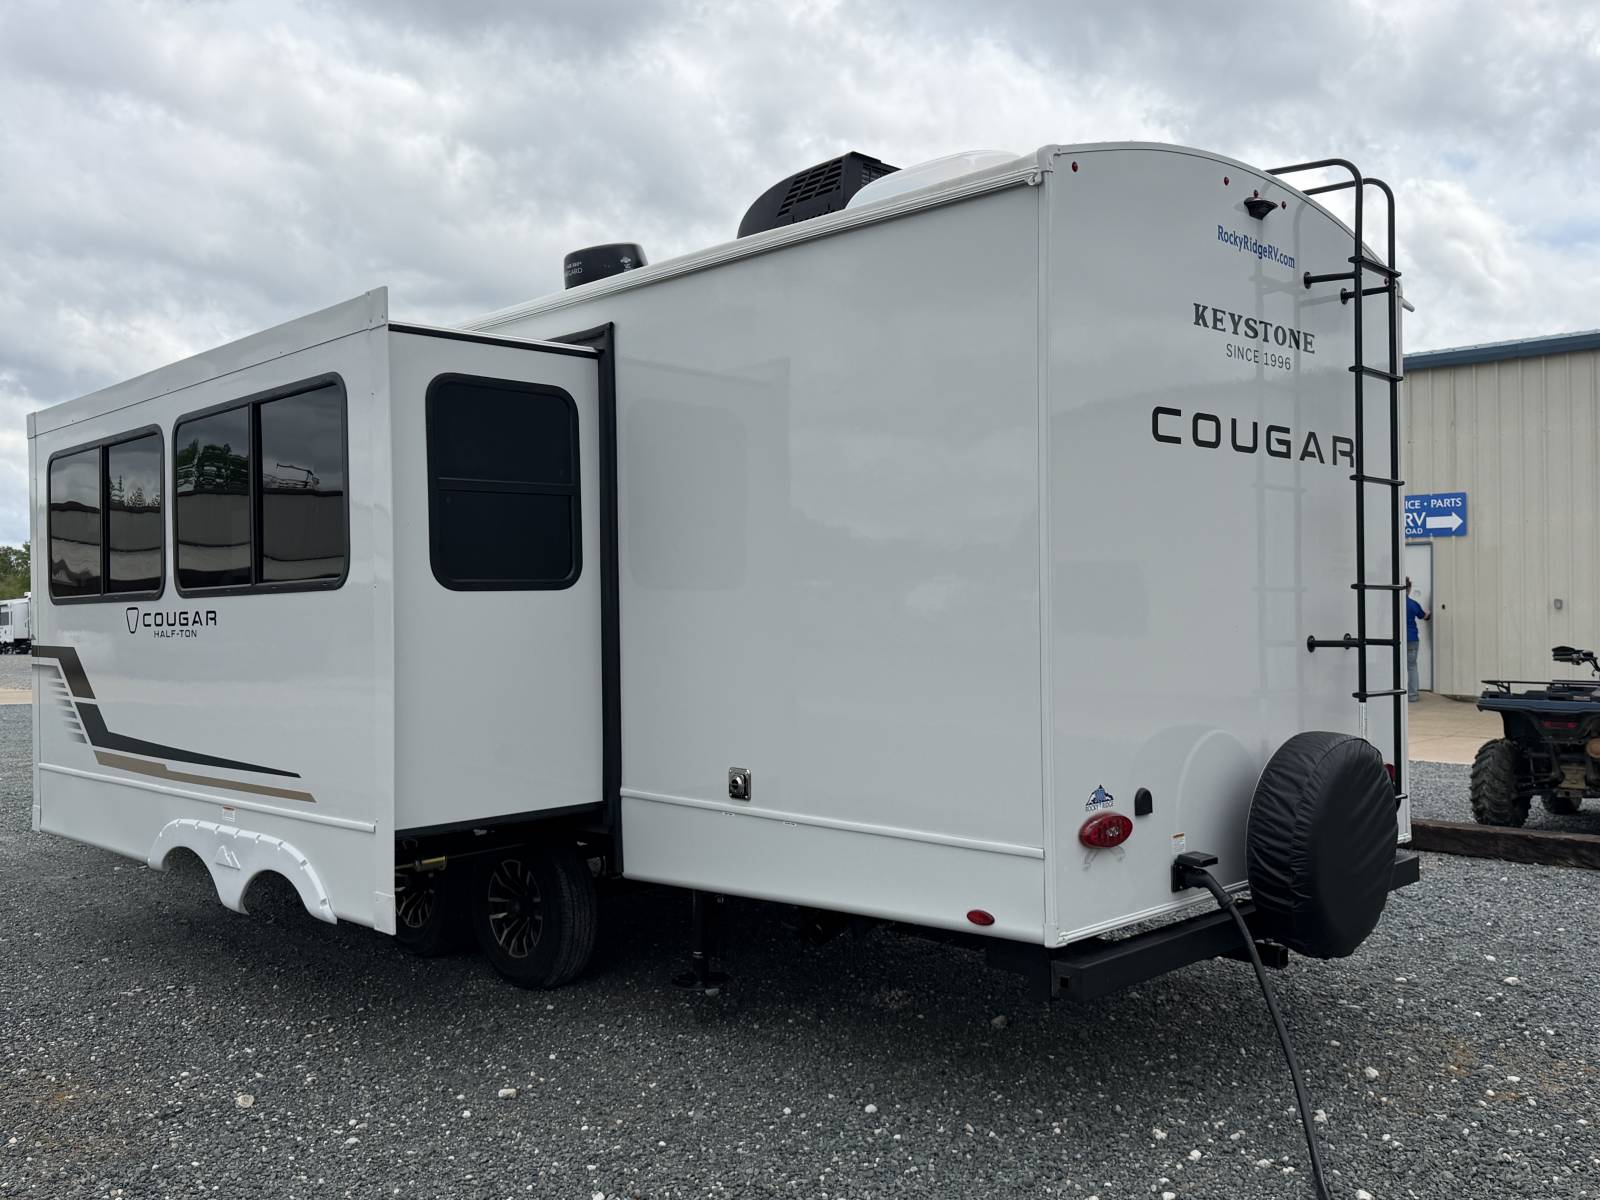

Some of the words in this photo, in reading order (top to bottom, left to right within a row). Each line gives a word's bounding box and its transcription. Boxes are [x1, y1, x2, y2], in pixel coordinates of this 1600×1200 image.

[1217, 224, 1296, 269] RockyRidgeRV.com
[1193, 302, 1316, 354] KEYSTONE
[1226, 343, 1260, 364] SINCE
[1263, 352, 1292, 371] 1996
[1151, 406, 1355, 468] COUGAR
[1405, 500, 1421, 509] ICE
[1430, 498, 1462, 508] PARTS
[142, 610, 217, 627] COUGAR
[154, 629, 197, 638] HALF-TON
